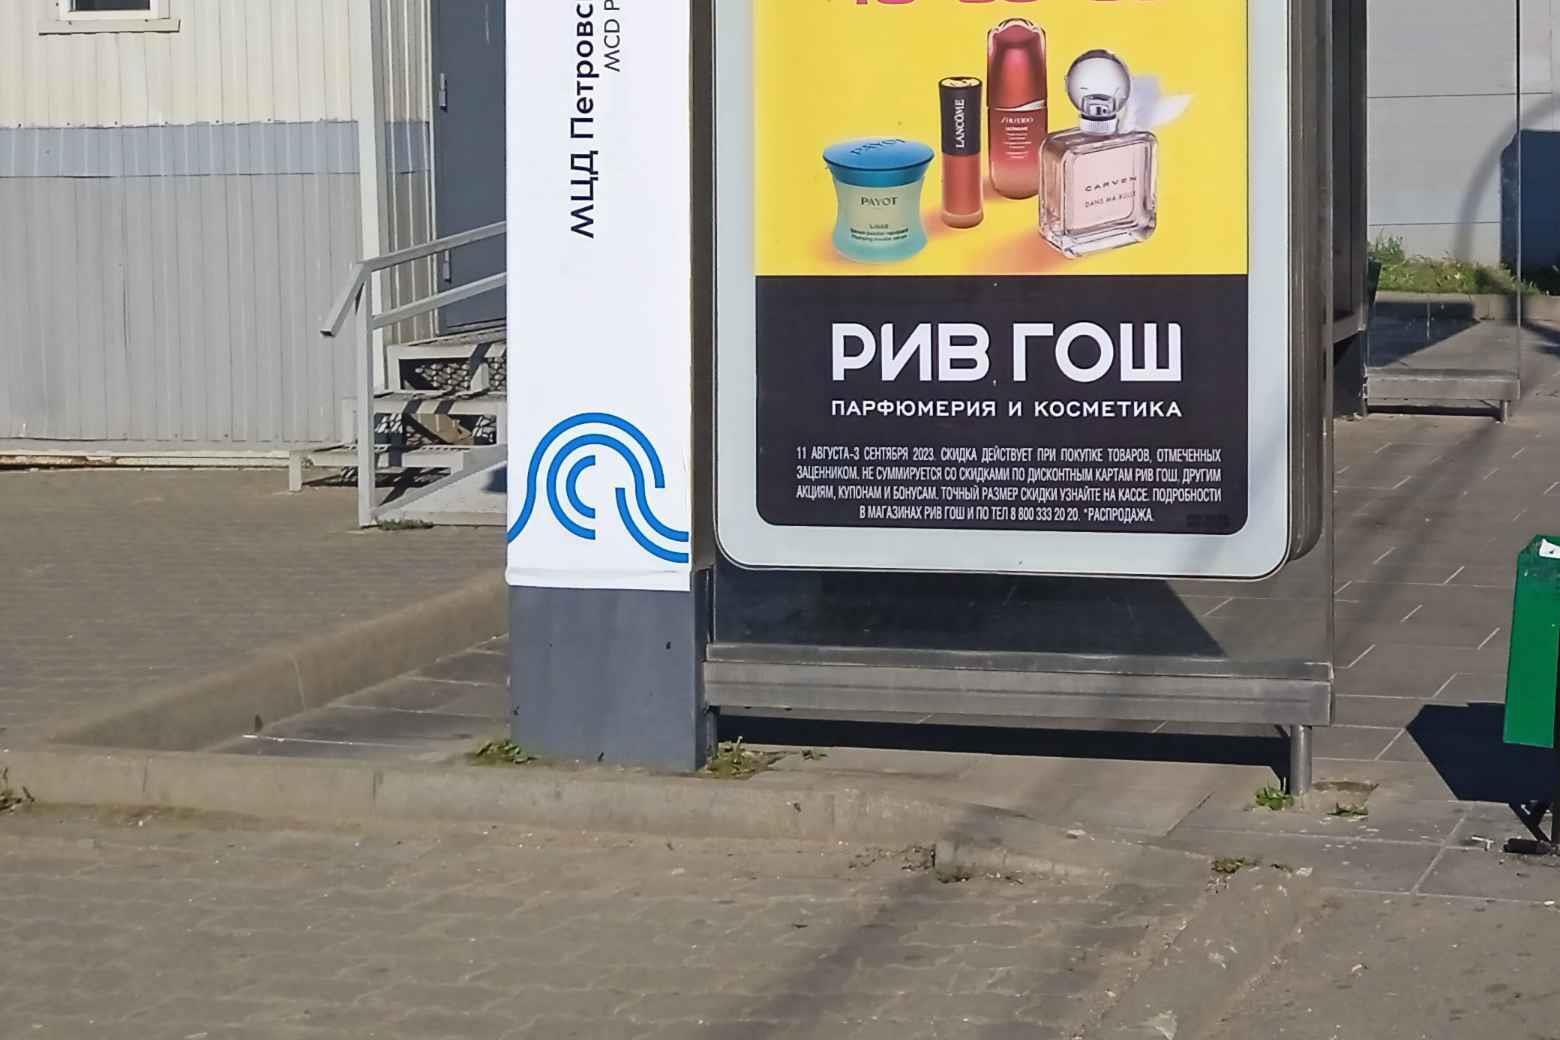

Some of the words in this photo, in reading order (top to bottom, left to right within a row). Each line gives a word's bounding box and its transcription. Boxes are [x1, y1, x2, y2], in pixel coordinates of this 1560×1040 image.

[603, 18, 621, 73] MCD
[570, 150, 599, 239] МЦД
[831, 322, 991, 383] РИВ
[1012, 321, 1183, 384] ГОШ
[831, 399, 996, 417] ПАРФЮМЕРИЯ
[1008, 401, 1022, 417] И
[1034, 400, 1183, 417] КОСМЕТИКА
[796, 446, 807, 460] 11
[863, 446, 909, 461] СЕНТЯБРЯ
[940, 447, 978, 463] СКИДКА
[981, 445, 1033, 463] ДЕЙСТВУЕТ
[1037, 448, 1057, 462] ПРИ
[1061, 448, 1103, 462] ПОКУПКЕ
[1156, 448, 1222, 462] ОТМЕЧЕННЫХ
[796, 465, 860, 481] ЗАЦЕННИКОМ.
[862, 467, 874, 480] НЕ
[876, 467, 942, 480] СУММИРУЕТСЯ
[944, 467, 957, 480] СО
[959, 467, 1010, 483] СКИДКАМИ
[1011, 467, 1025, 481] ПО
[1027, 467, 1093, 484] ДИСКОНТНЫМ
[1095, 468, 1133, 482] КАРТАМ
[1135, 468, 1154, 482] РИВ
[1182, 468, 1222, 485] ДРУГИМ
[796, 485, 836, 500] АКЦИЯМ,
[838, 485, 882, 499] КУПОНАМ
[883, 486, 891, 499] И
[893, 486, 939, 500] БОНУСАМ.
[941, 485, 980, 501] ТОЧНЫЙ
[982, 487, 1019, 501] РАЗМЕР
[1020, 487, 1058, 503] СКИДКИ
[1059, 486, 1101, 502] УЗНАЙТЕ
[1103, 488, 1116, 501] НА
[1152, 488, 1222, 504] ПОДРОБНОСТИ
[859, 505, 866, 519] В
[867, 505, 923, 519] МАГАЗИНАХ
[924, 506, 942, 520] РИВ
[944, 506, 965, 520] ГОШ
[967, 506, 974, 520] И
[976, 506, 989, 520] ПО
[1010, 507, 1017, 521] 8
[1018, 507, 1034, 521] 800
[1035, 507, 1053, 521] 333
[1054, 507, 1066, 521] 20
